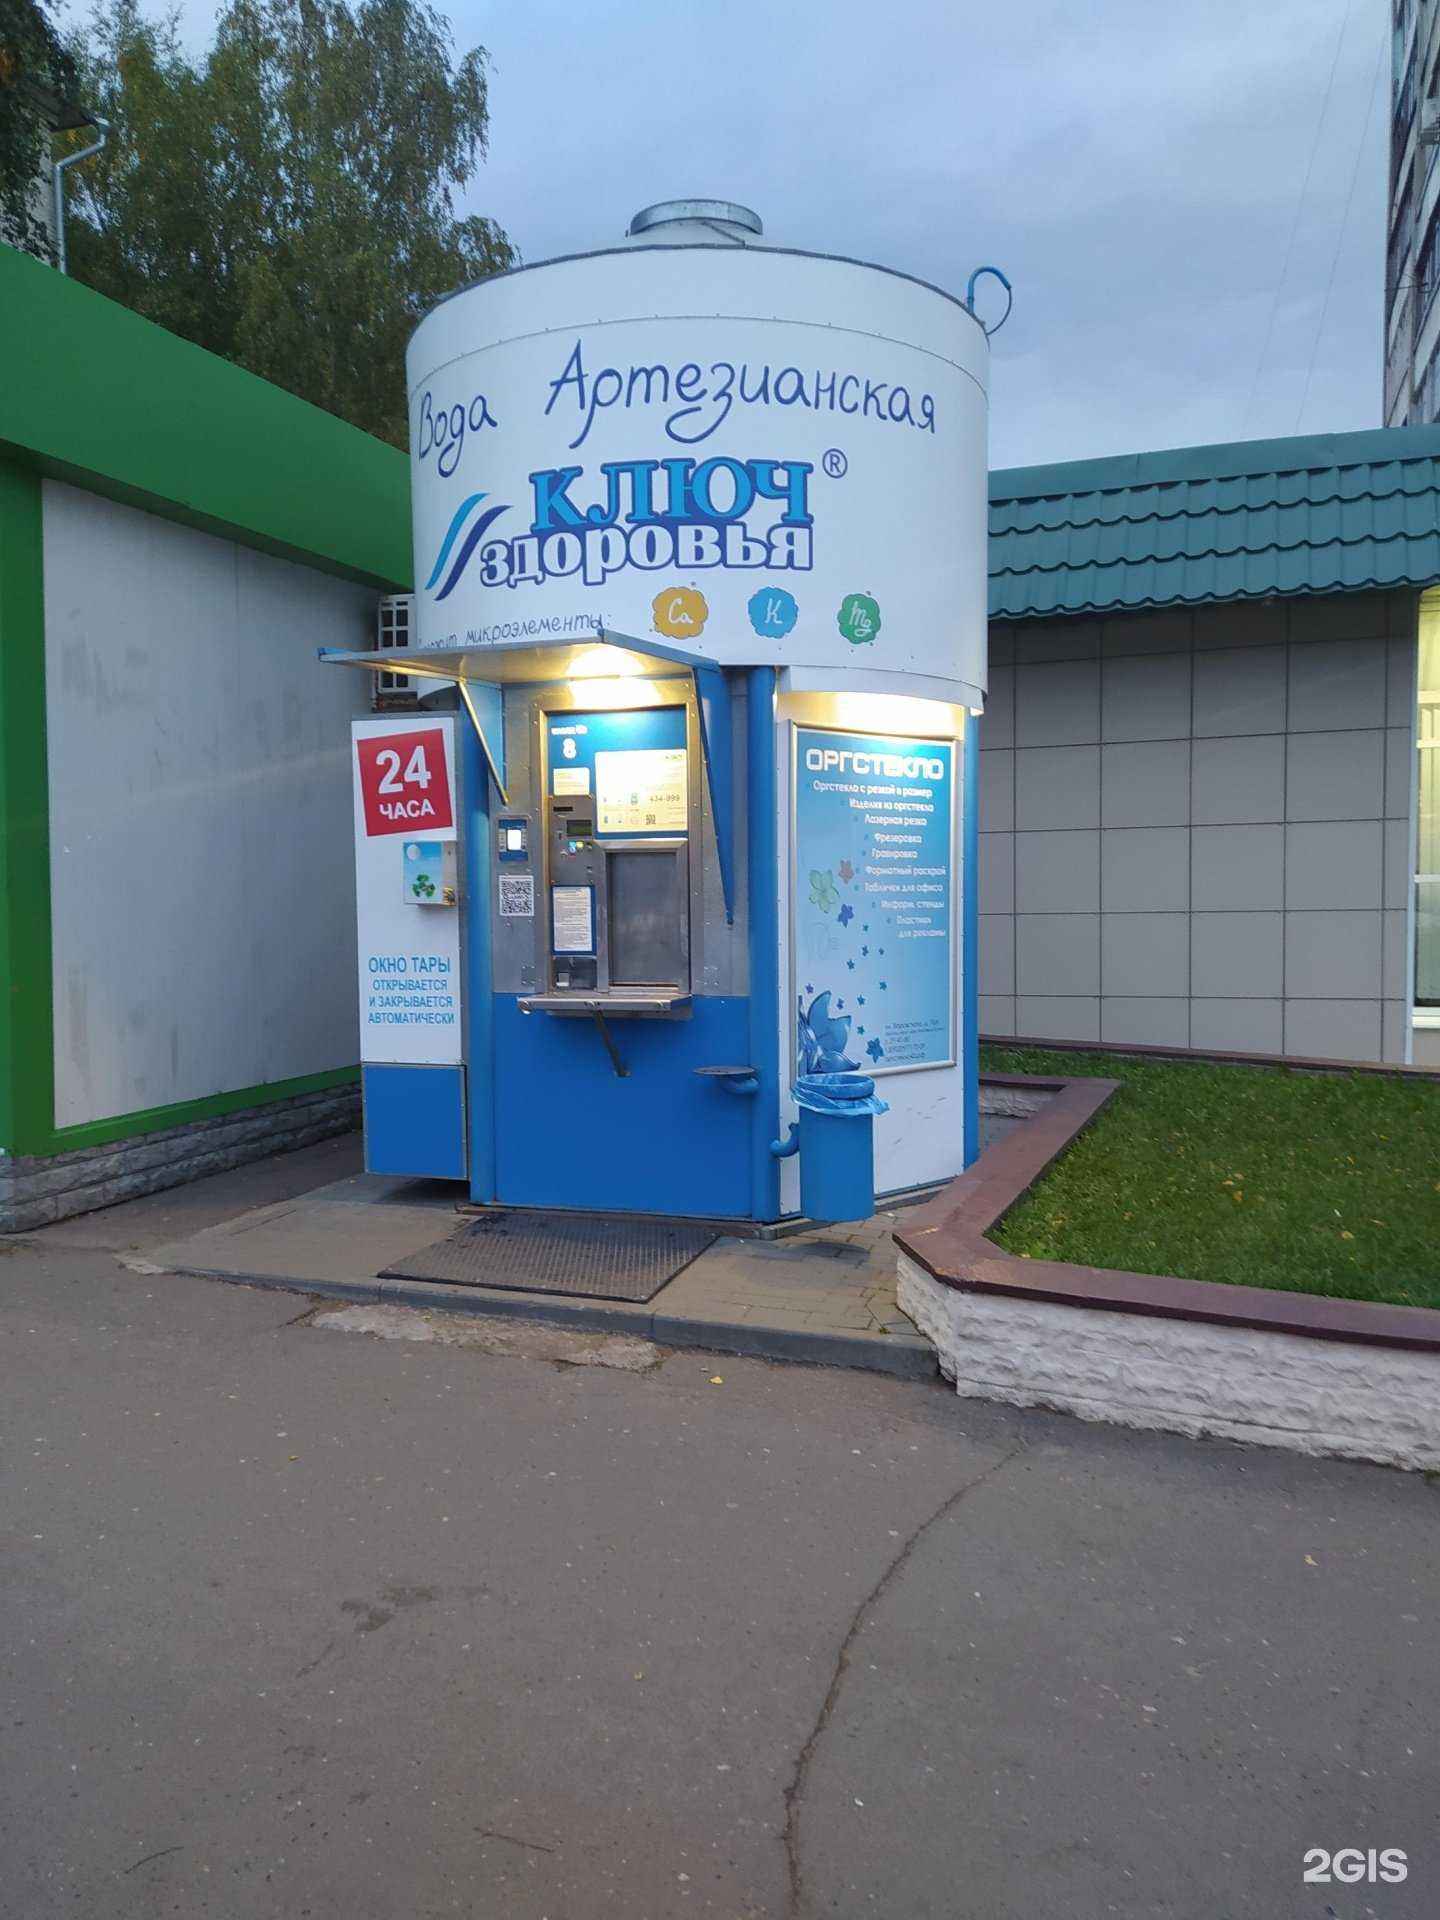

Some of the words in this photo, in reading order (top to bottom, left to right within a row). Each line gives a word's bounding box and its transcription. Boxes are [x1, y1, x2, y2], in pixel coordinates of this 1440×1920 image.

[418, 391, 498, 477] Вода
[544, 338, 936, 450] Артезианская
[529, 456, 814, 532] КЛЮЧ
[375, 745, 432, 795] 24
[806, 748, 945, 780] ОРГСТЕКЛО
[379, 798, 436, 820] ЧАСА
[368, 956, 407, 973] ОКНО
[411, 956, 451, 973] ТАРЫ
[372, 979, 448, 991] ОТКРЫВАЕТСЯ
[368, 995, 376, 1007] И
[379, 995, 453, 1008] ЗАКРЫВАЕТСЯ
[368, 1012, 455, 1024] АВТОМАТИЧЕСКИ
